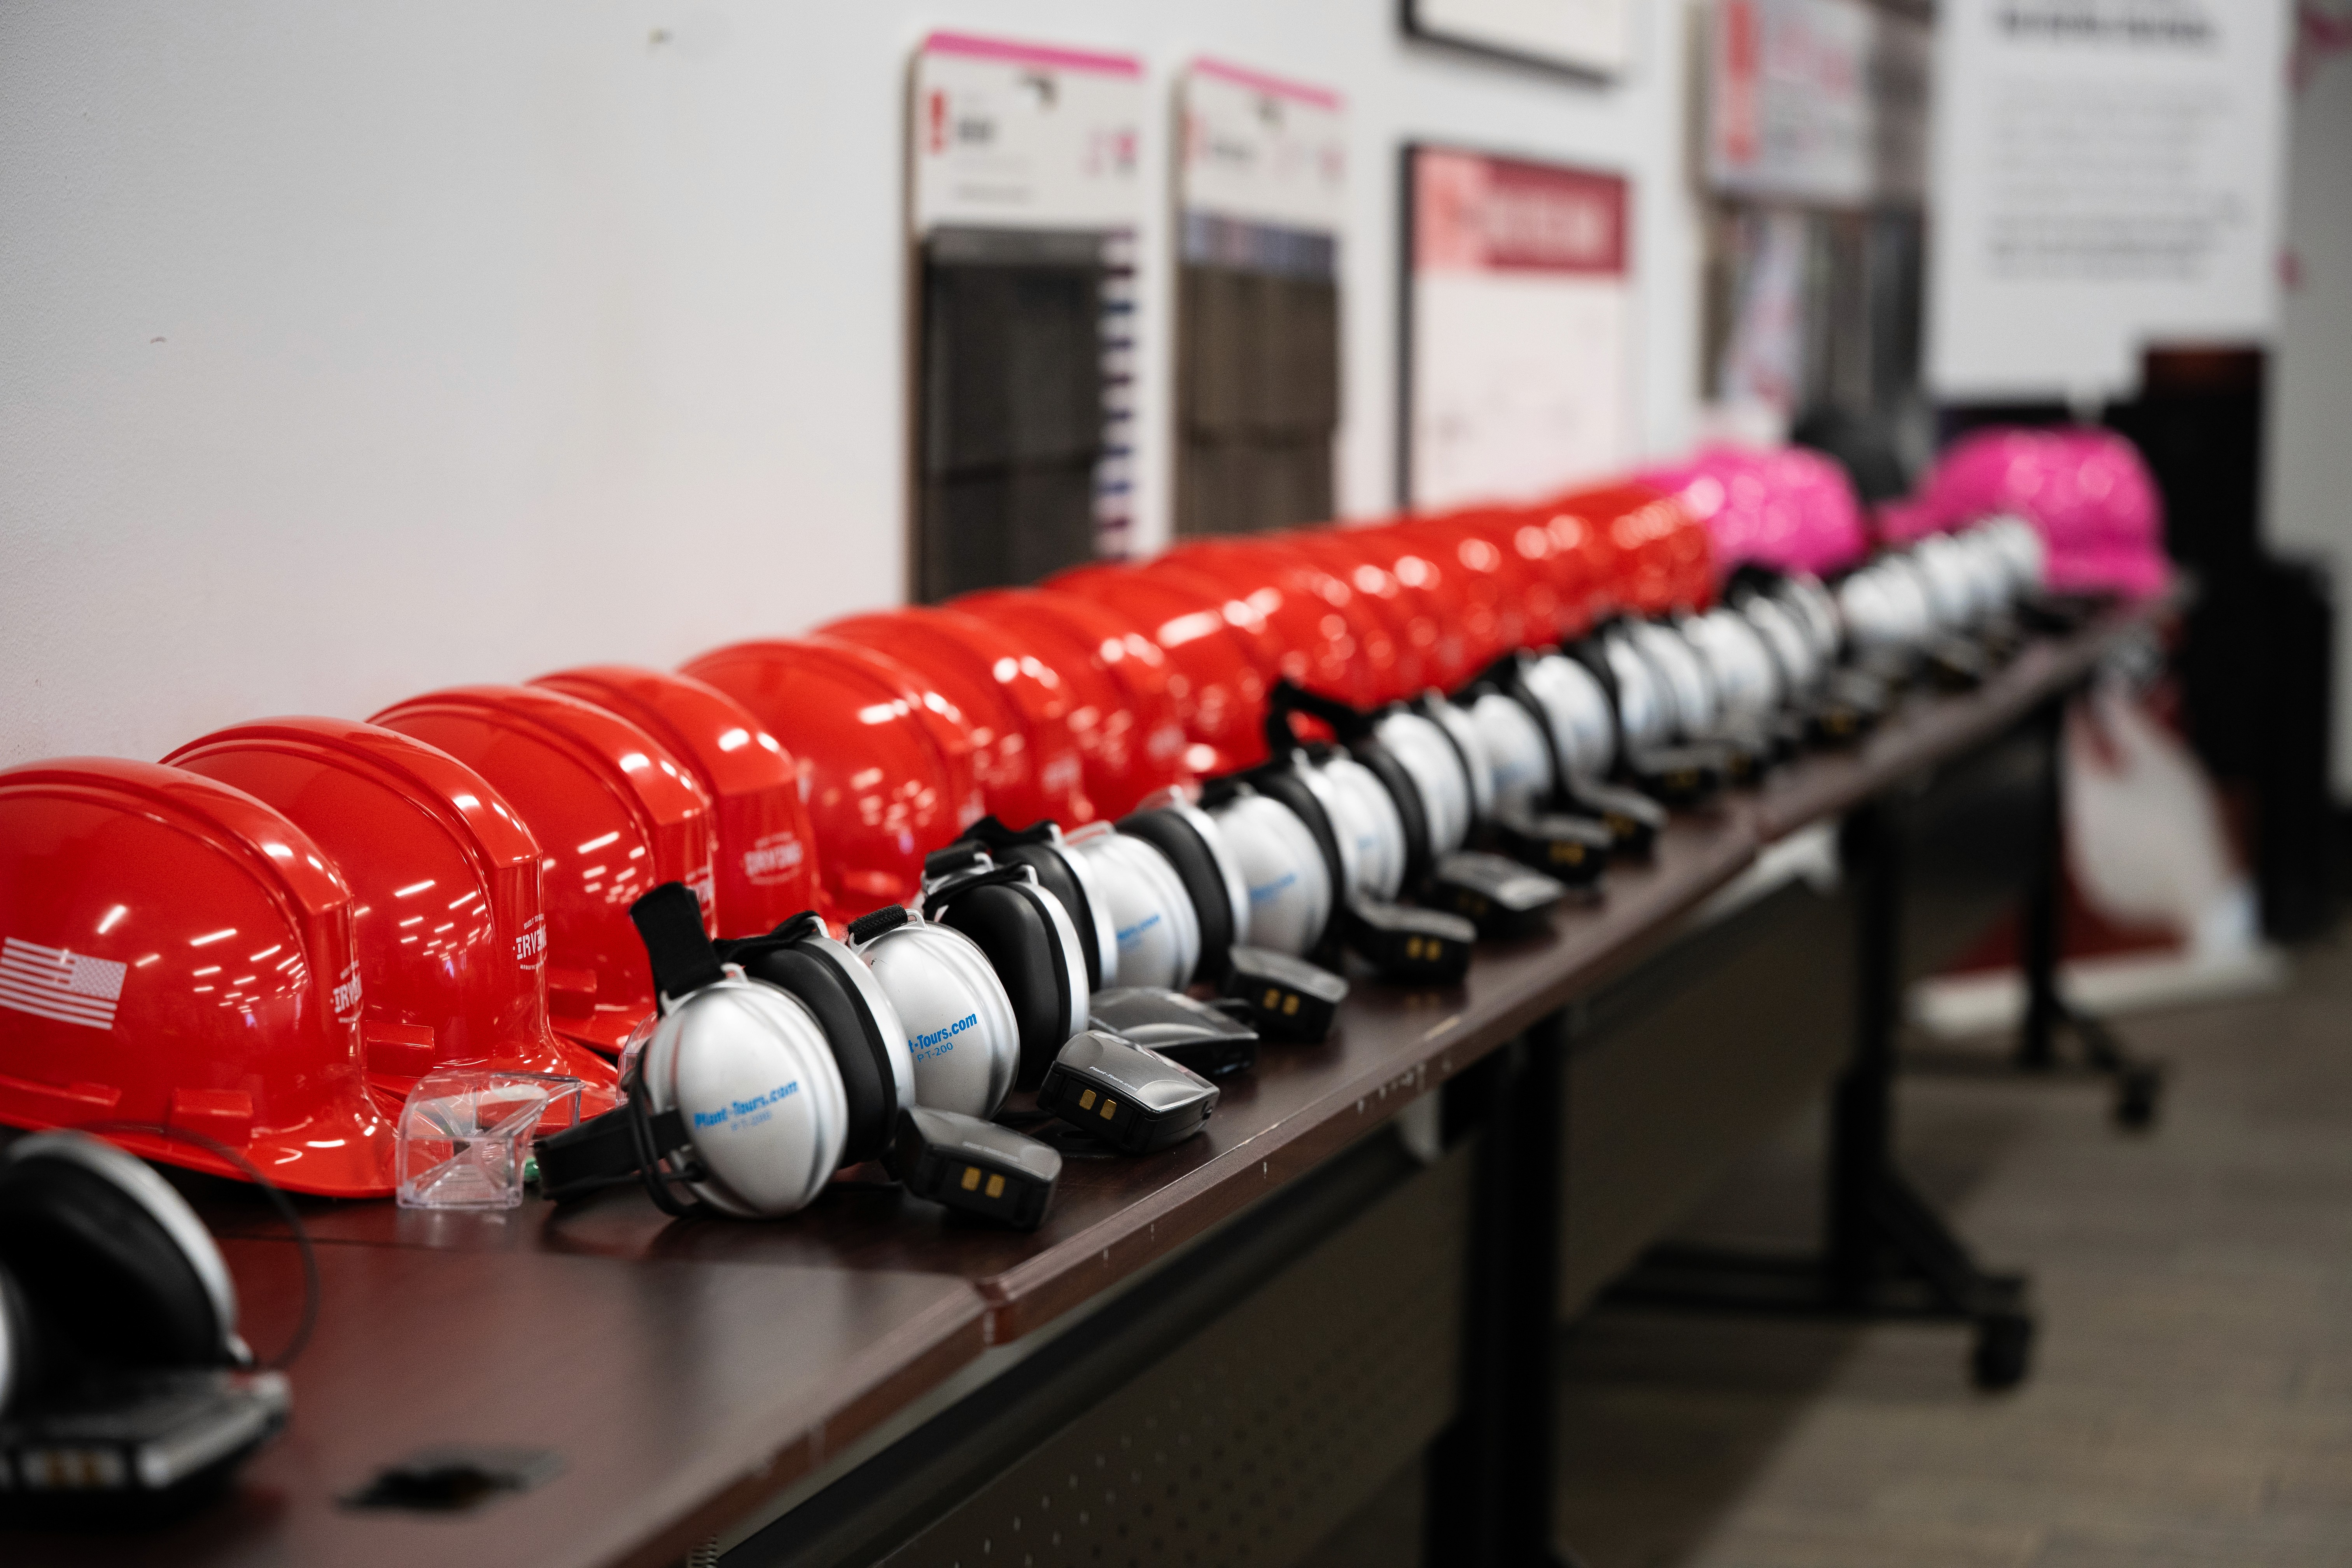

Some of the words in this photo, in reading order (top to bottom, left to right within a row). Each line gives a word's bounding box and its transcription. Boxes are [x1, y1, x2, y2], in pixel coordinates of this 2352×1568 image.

[524, 918, 534, 930] BUILT
[908, 1013, 977, 1053] t-Tours.com
[1089, 1066, 1138, 1091] Plant-Tours.com
